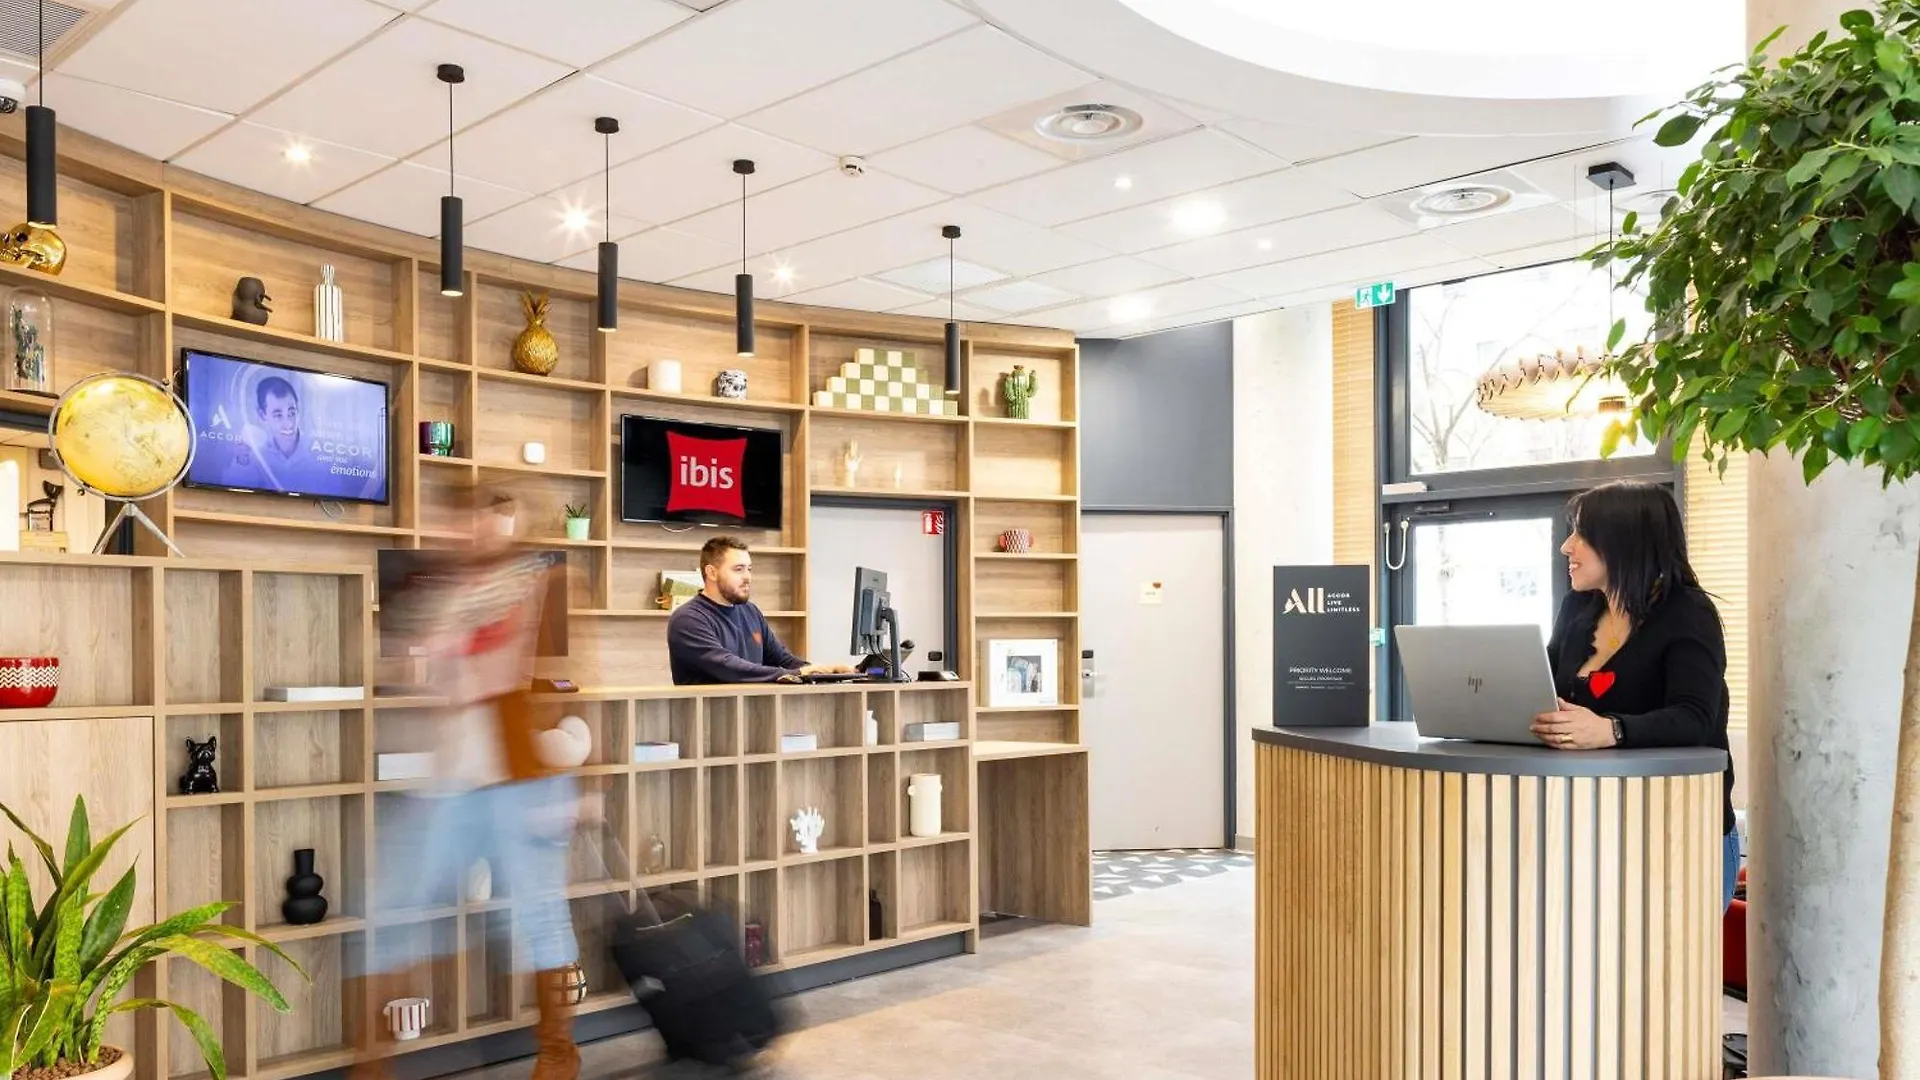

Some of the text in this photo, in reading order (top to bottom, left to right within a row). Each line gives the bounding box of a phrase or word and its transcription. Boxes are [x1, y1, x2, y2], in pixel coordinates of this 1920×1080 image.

[310, 441, 371, 458] ACCOR
[680, 455, 733, 489] ibis
[1468, 676, 1482, 693] hp
